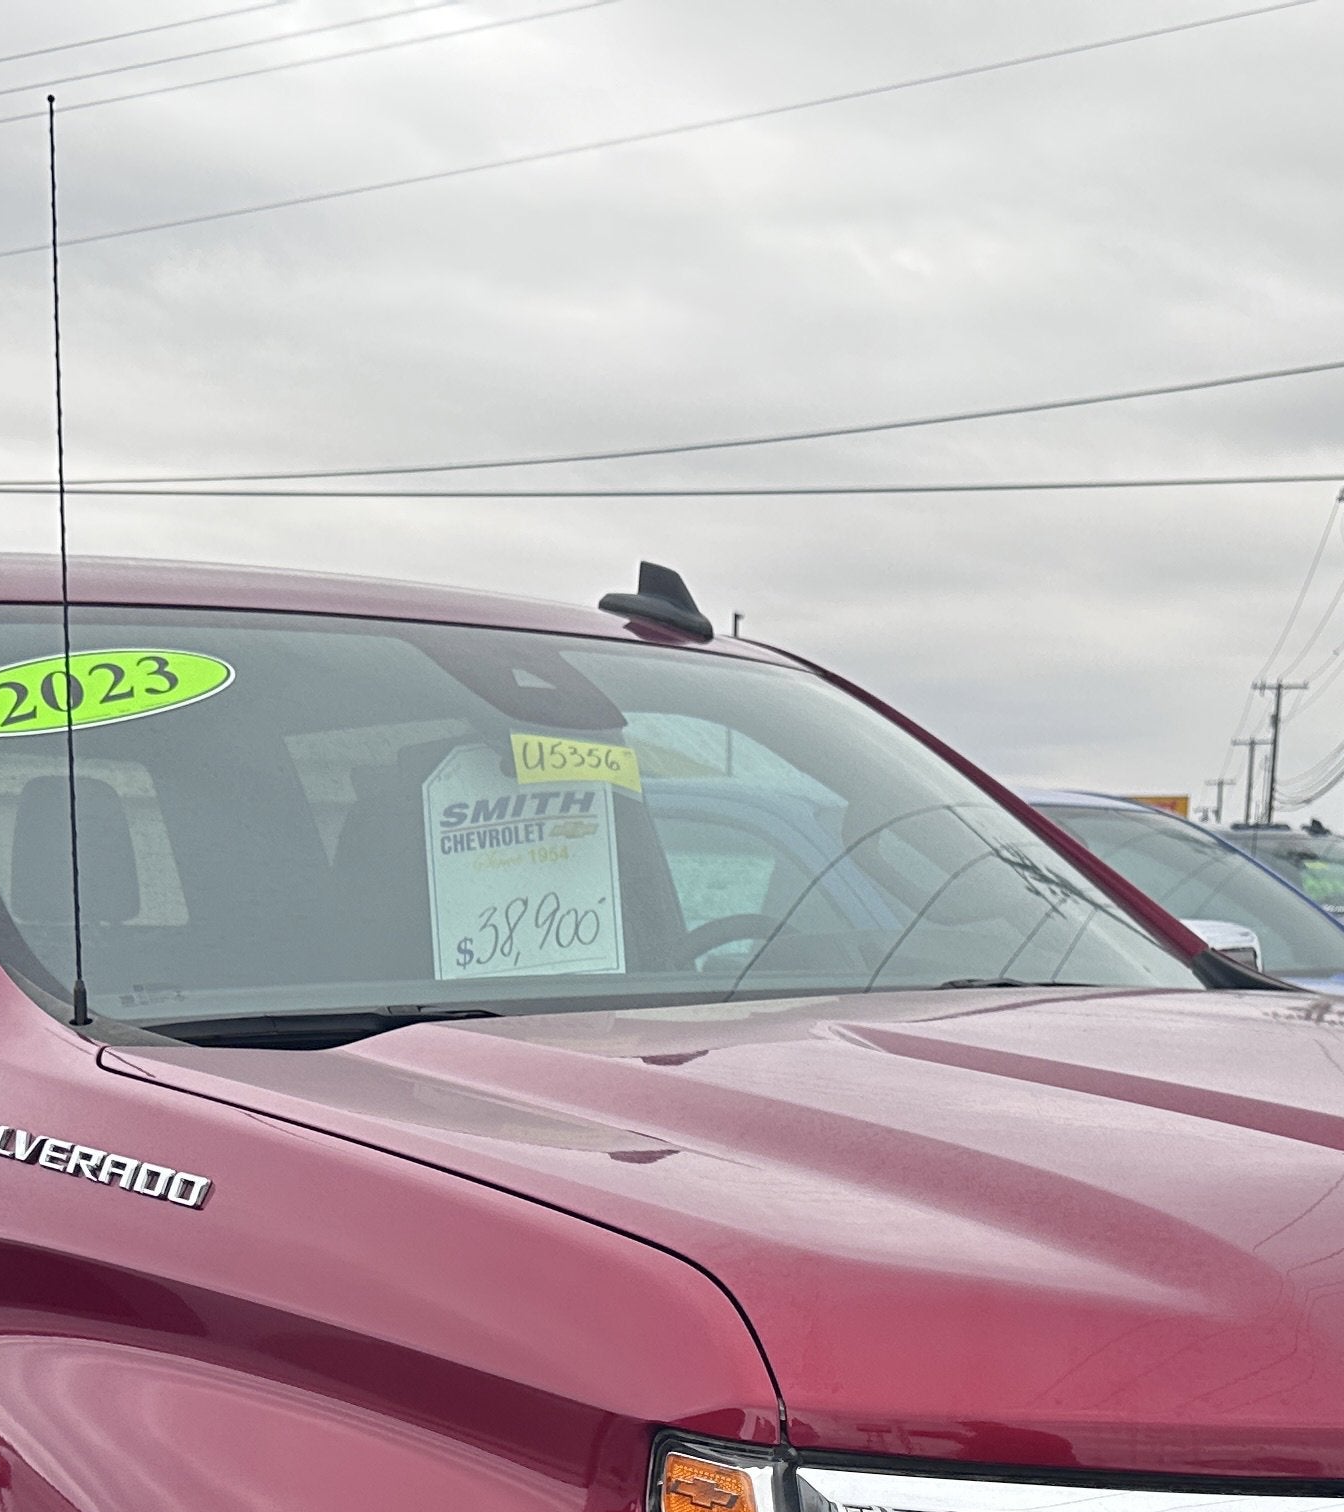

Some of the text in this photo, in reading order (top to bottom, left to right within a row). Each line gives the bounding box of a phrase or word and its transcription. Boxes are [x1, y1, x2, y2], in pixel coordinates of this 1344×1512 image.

[522, 741, 621, 772] U5356
[439, 791, 596, 828] SMITH
[440, 821, 546, 855] CHEVROLET
